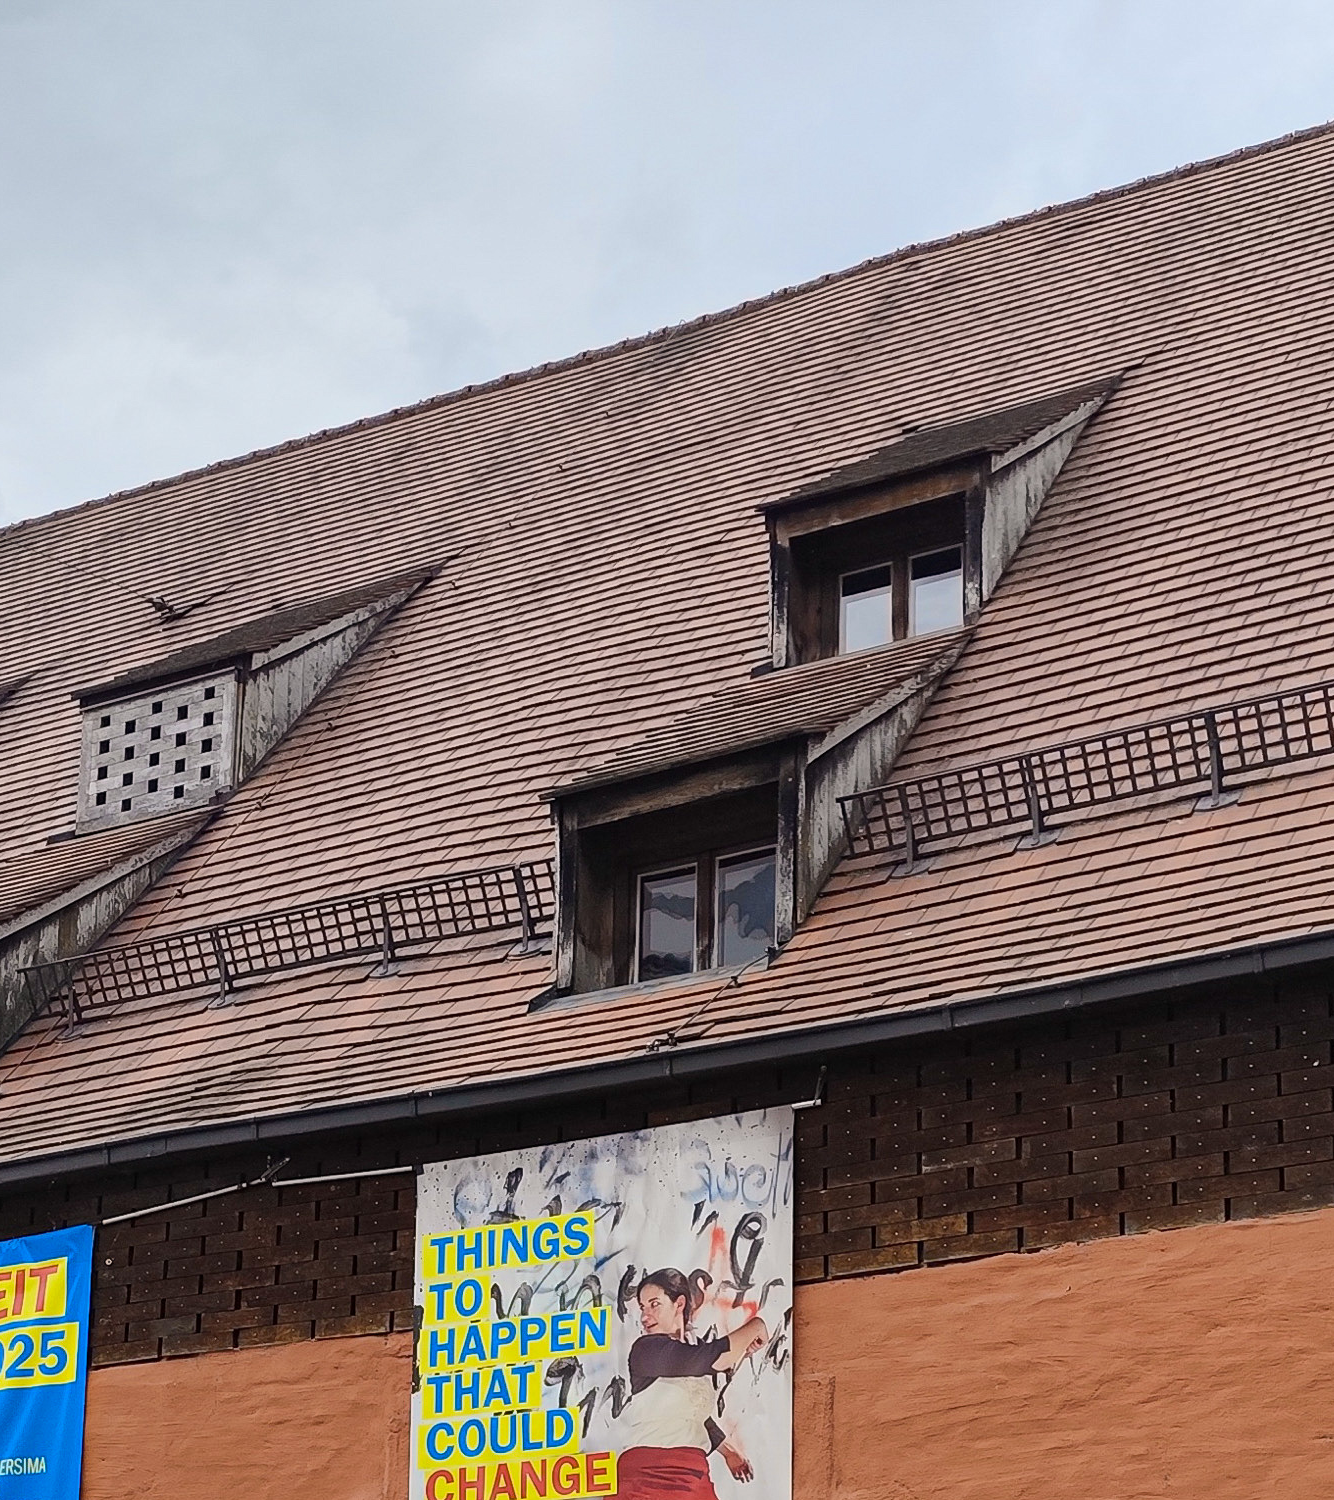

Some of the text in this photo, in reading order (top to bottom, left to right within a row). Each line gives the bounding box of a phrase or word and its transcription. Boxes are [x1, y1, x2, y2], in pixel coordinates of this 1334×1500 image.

[429, 1217, 590, 1274] THINGS
[429, 1279, 482, 1321] TO
[428, 1309, 607, 1367] HAPPEN
[427, 1364, 535, 1413] THAT
[426, 1409, 574, 1461] COULD
